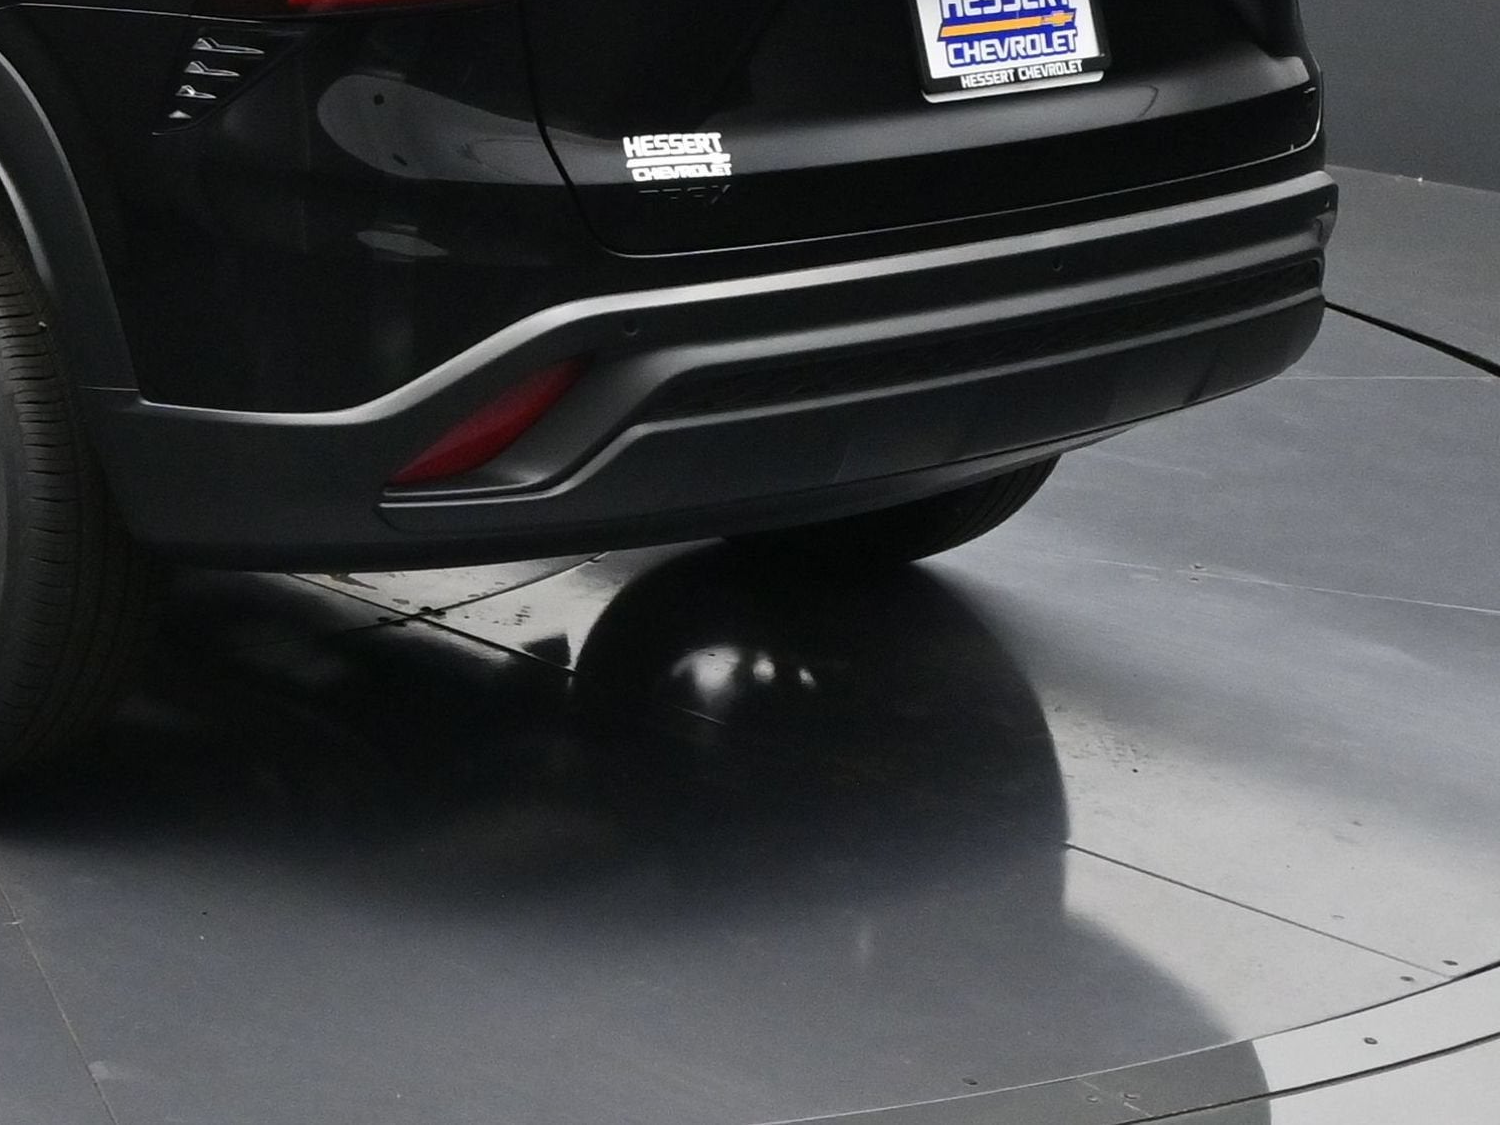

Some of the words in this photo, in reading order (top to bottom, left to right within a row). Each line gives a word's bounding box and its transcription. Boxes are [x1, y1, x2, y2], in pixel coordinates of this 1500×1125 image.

[948, 29, 1078, 66] CHEVROLET
[961, 69, 1015, 89] HESSERT
[1018, 59, 1083, 81] CHEVROLET
[622, 132, 722, 158] HESSERT
[631, 163, 732, 182] CHEVROLET
